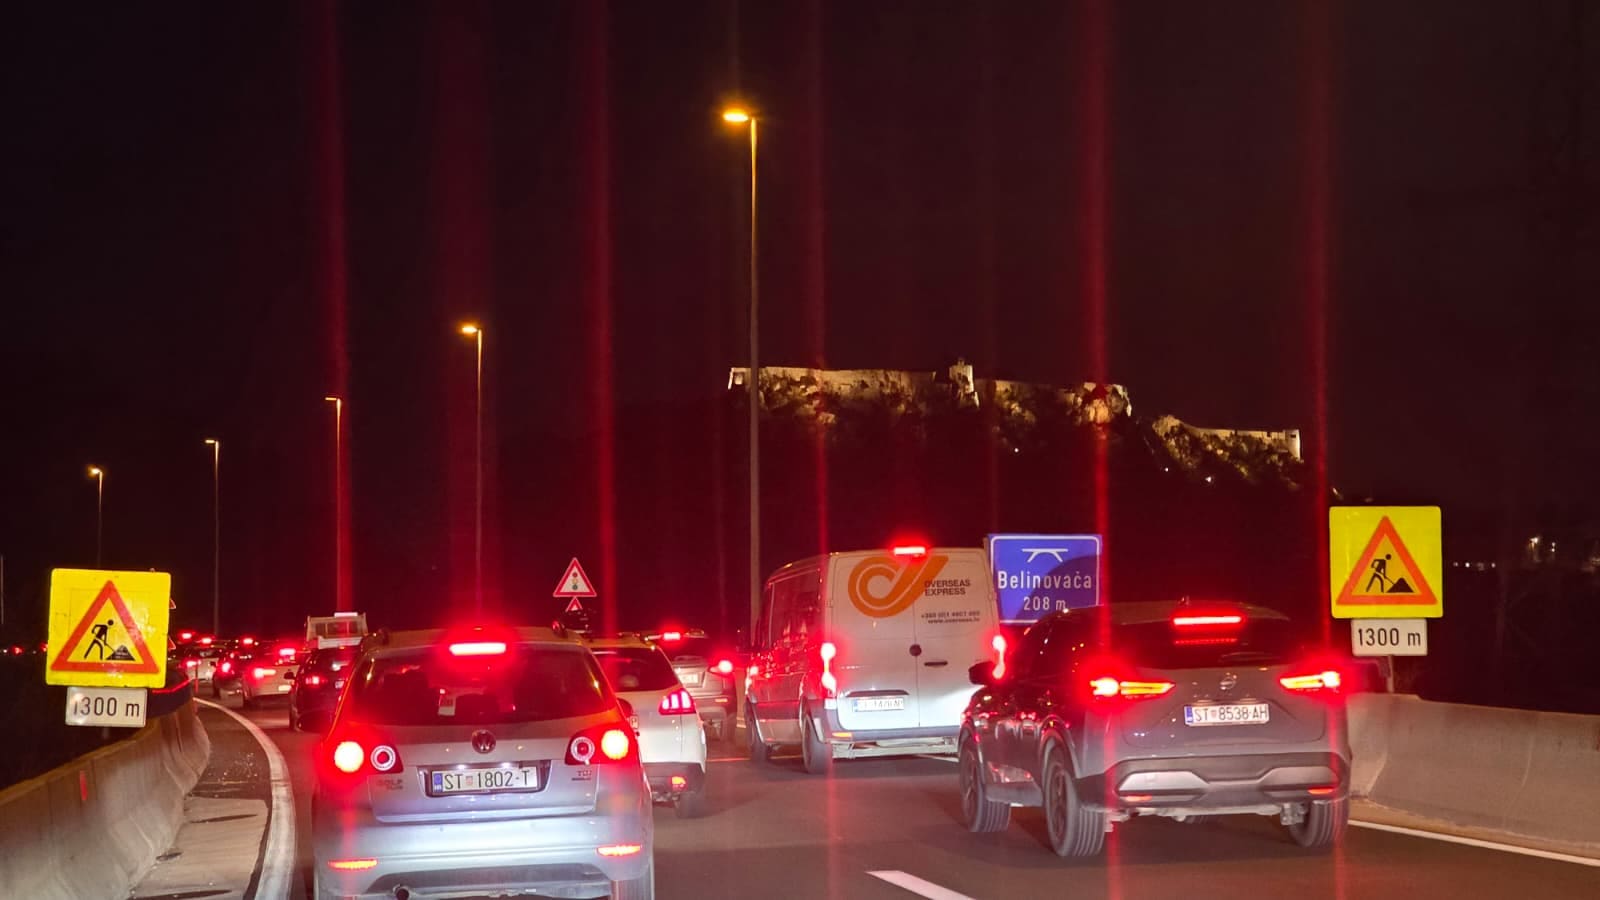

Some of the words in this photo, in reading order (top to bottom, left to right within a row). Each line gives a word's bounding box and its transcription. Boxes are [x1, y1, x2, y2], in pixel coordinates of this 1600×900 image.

[923, 579, 971, 588] OVERSEAS
[997, 570, 1092, 589] Belinovača
[924, 587, 966, 596] EXPRESS
[1023, 596, 1050, 611] 208
[1055, 599, 1066, 610] m
[1358, 627, 1399, 646] 1300
[1407, 632, 1421, 646] m
[73, 696, 117, 716] 1300
[125, 703, 140, 717] m
[1194, 708, 1209, 721] ST
[444, 773, 463, 790] ST
[477, 769, 530, 788] 1802-T
